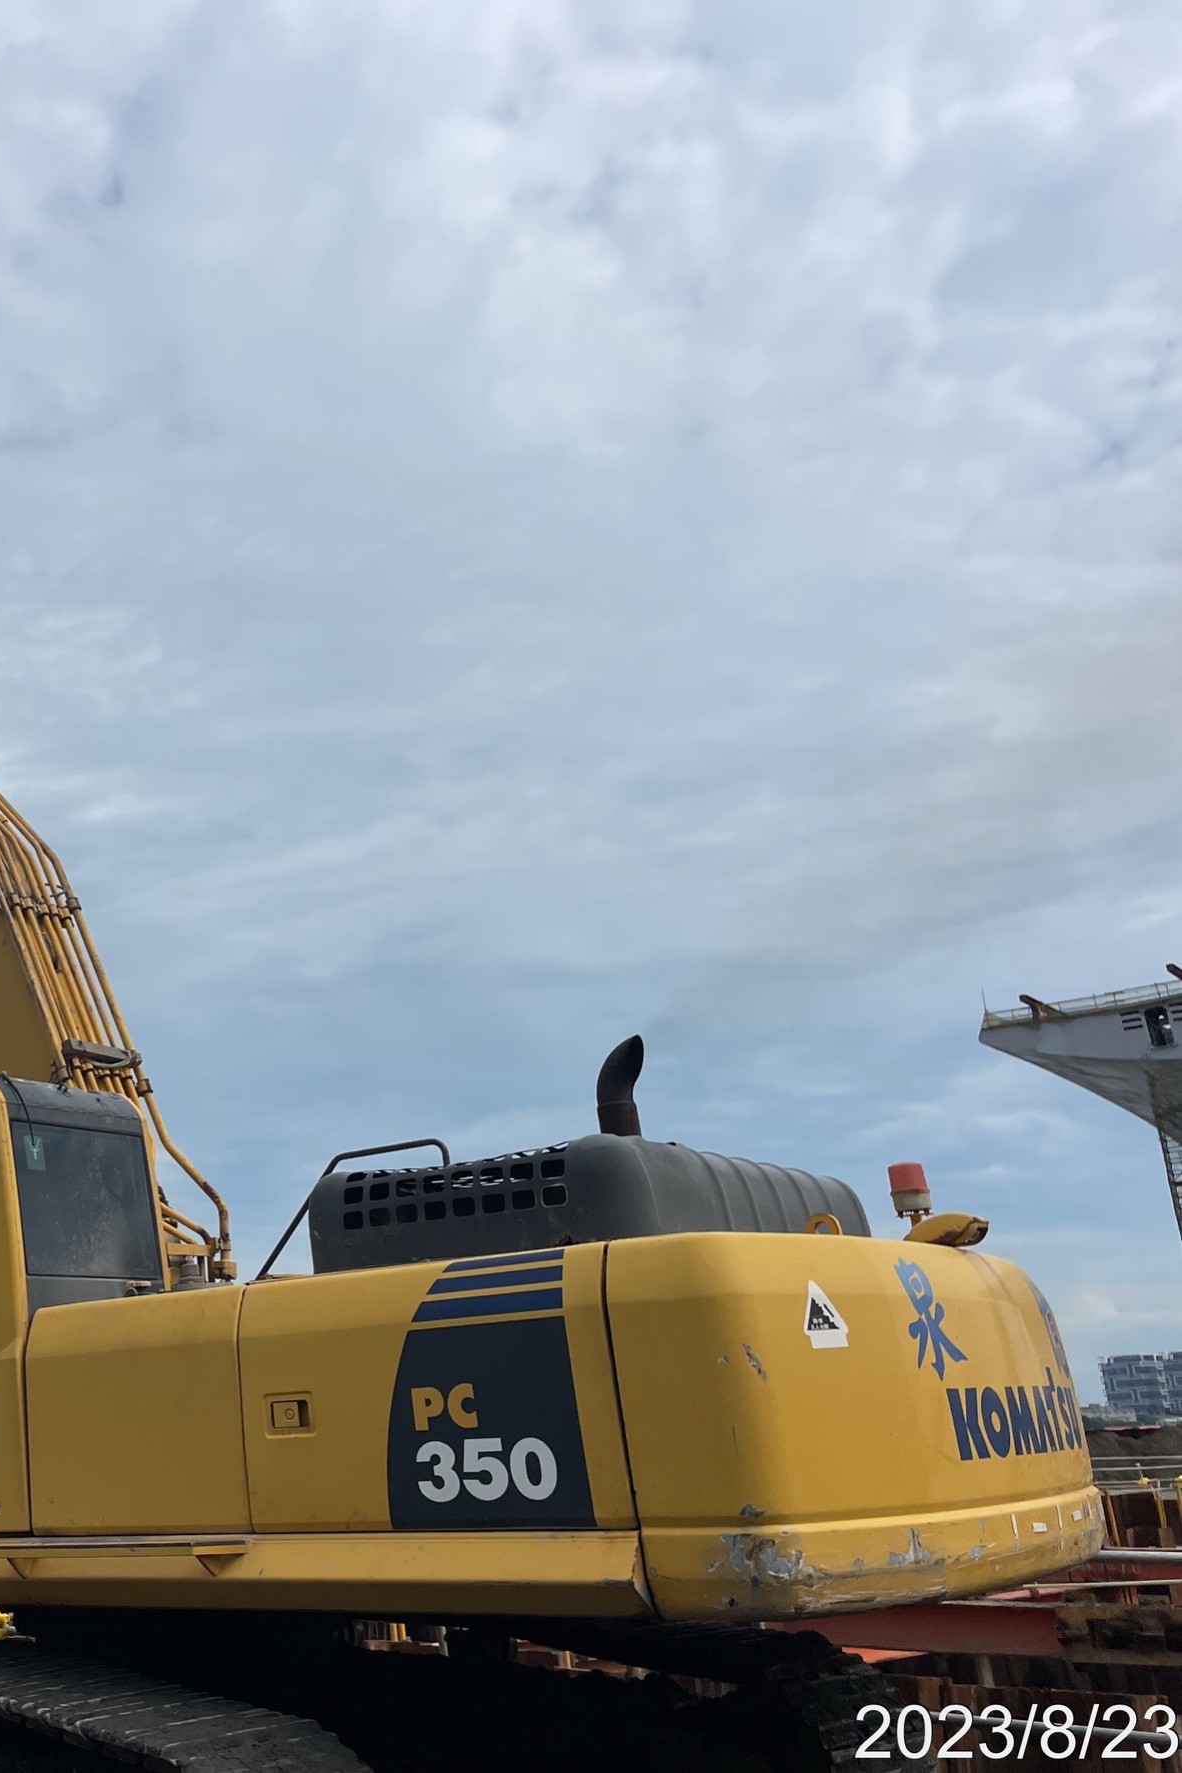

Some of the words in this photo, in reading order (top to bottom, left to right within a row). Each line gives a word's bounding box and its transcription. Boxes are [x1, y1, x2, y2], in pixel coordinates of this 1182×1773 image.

[410, 1382, 479, 1432] PC
[946, 1366, 1082, 1461] KOMATSU
[416, 1436, 558, 1503] 350
